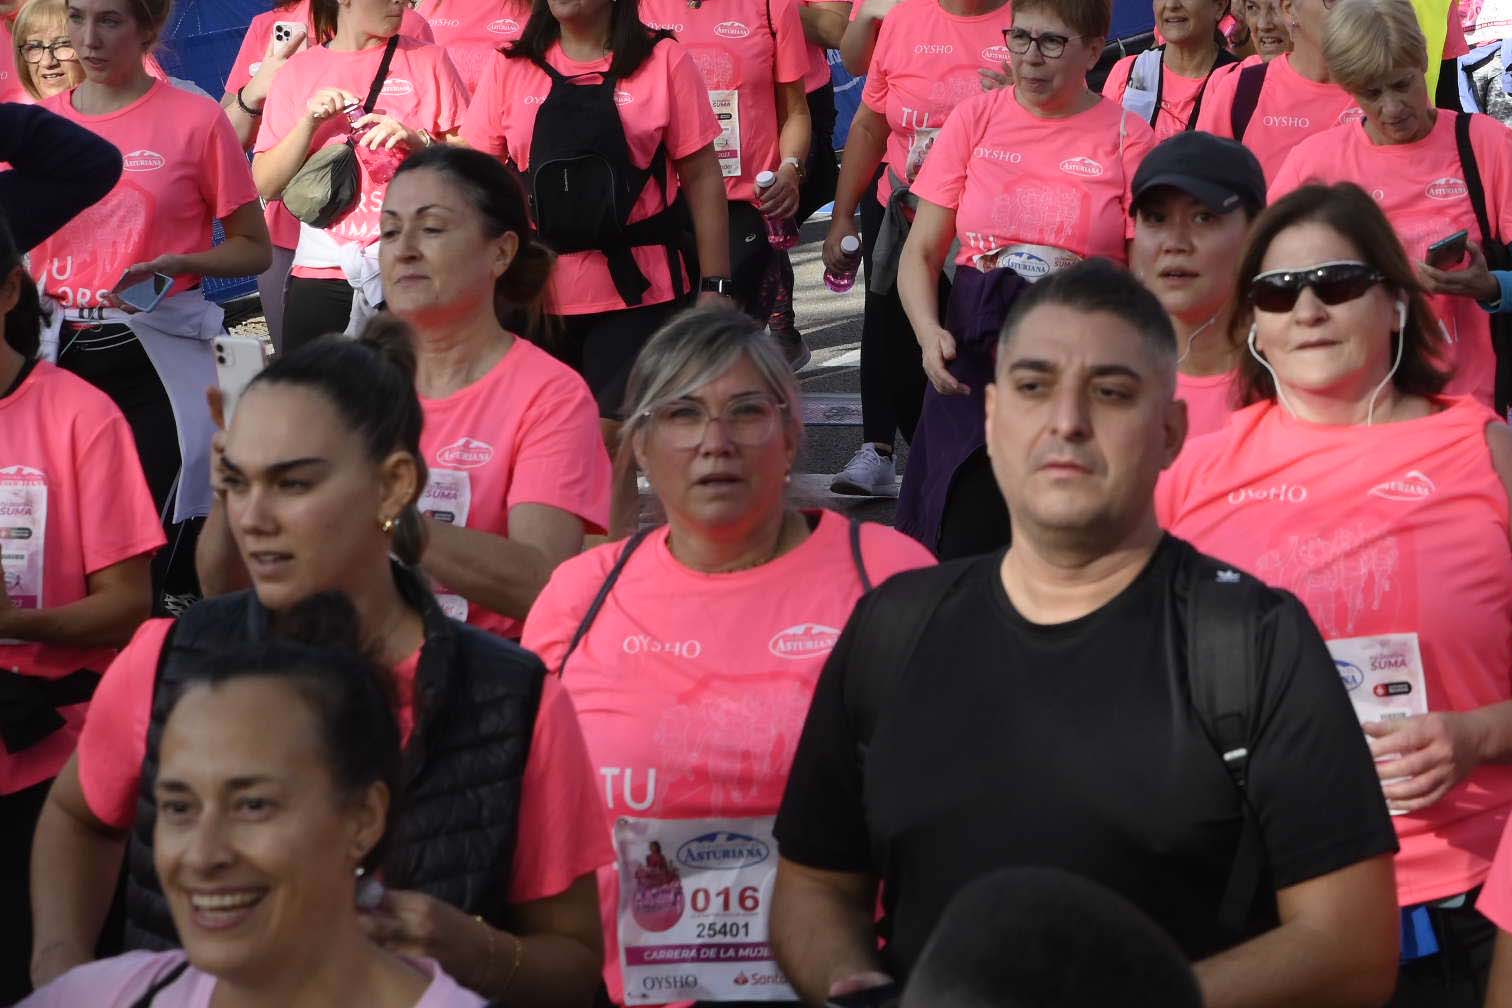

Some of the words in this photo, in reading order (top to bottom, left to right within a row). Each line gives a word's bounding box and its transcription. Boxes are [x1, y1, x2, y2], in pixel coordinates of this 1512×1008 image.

[913, 44, 953, 55] OYSHO
[901, 107, 930, 130] TU
[1263, 116, 1309, 128] OYSHO
[973, 147, 1022, 164] OYSHO
[1063, 161, 1101, 176] ASTURIANA
[622, 635, 701, 660] OYSHO
[1369, 657, 1409, 672] SUMA
[600, 767, 656, 810] TU
[683, 848, 764, 863] ASTURIANA
[690, 885, 761, 913] 016
[696, 921, 750, 939] 25401
[643, 946, 698, 961] CARRERA
[700, 947, 718, 959] DE
[720, 947, 736, 958] LA
[643, 975, 698, 991] OYSHO
